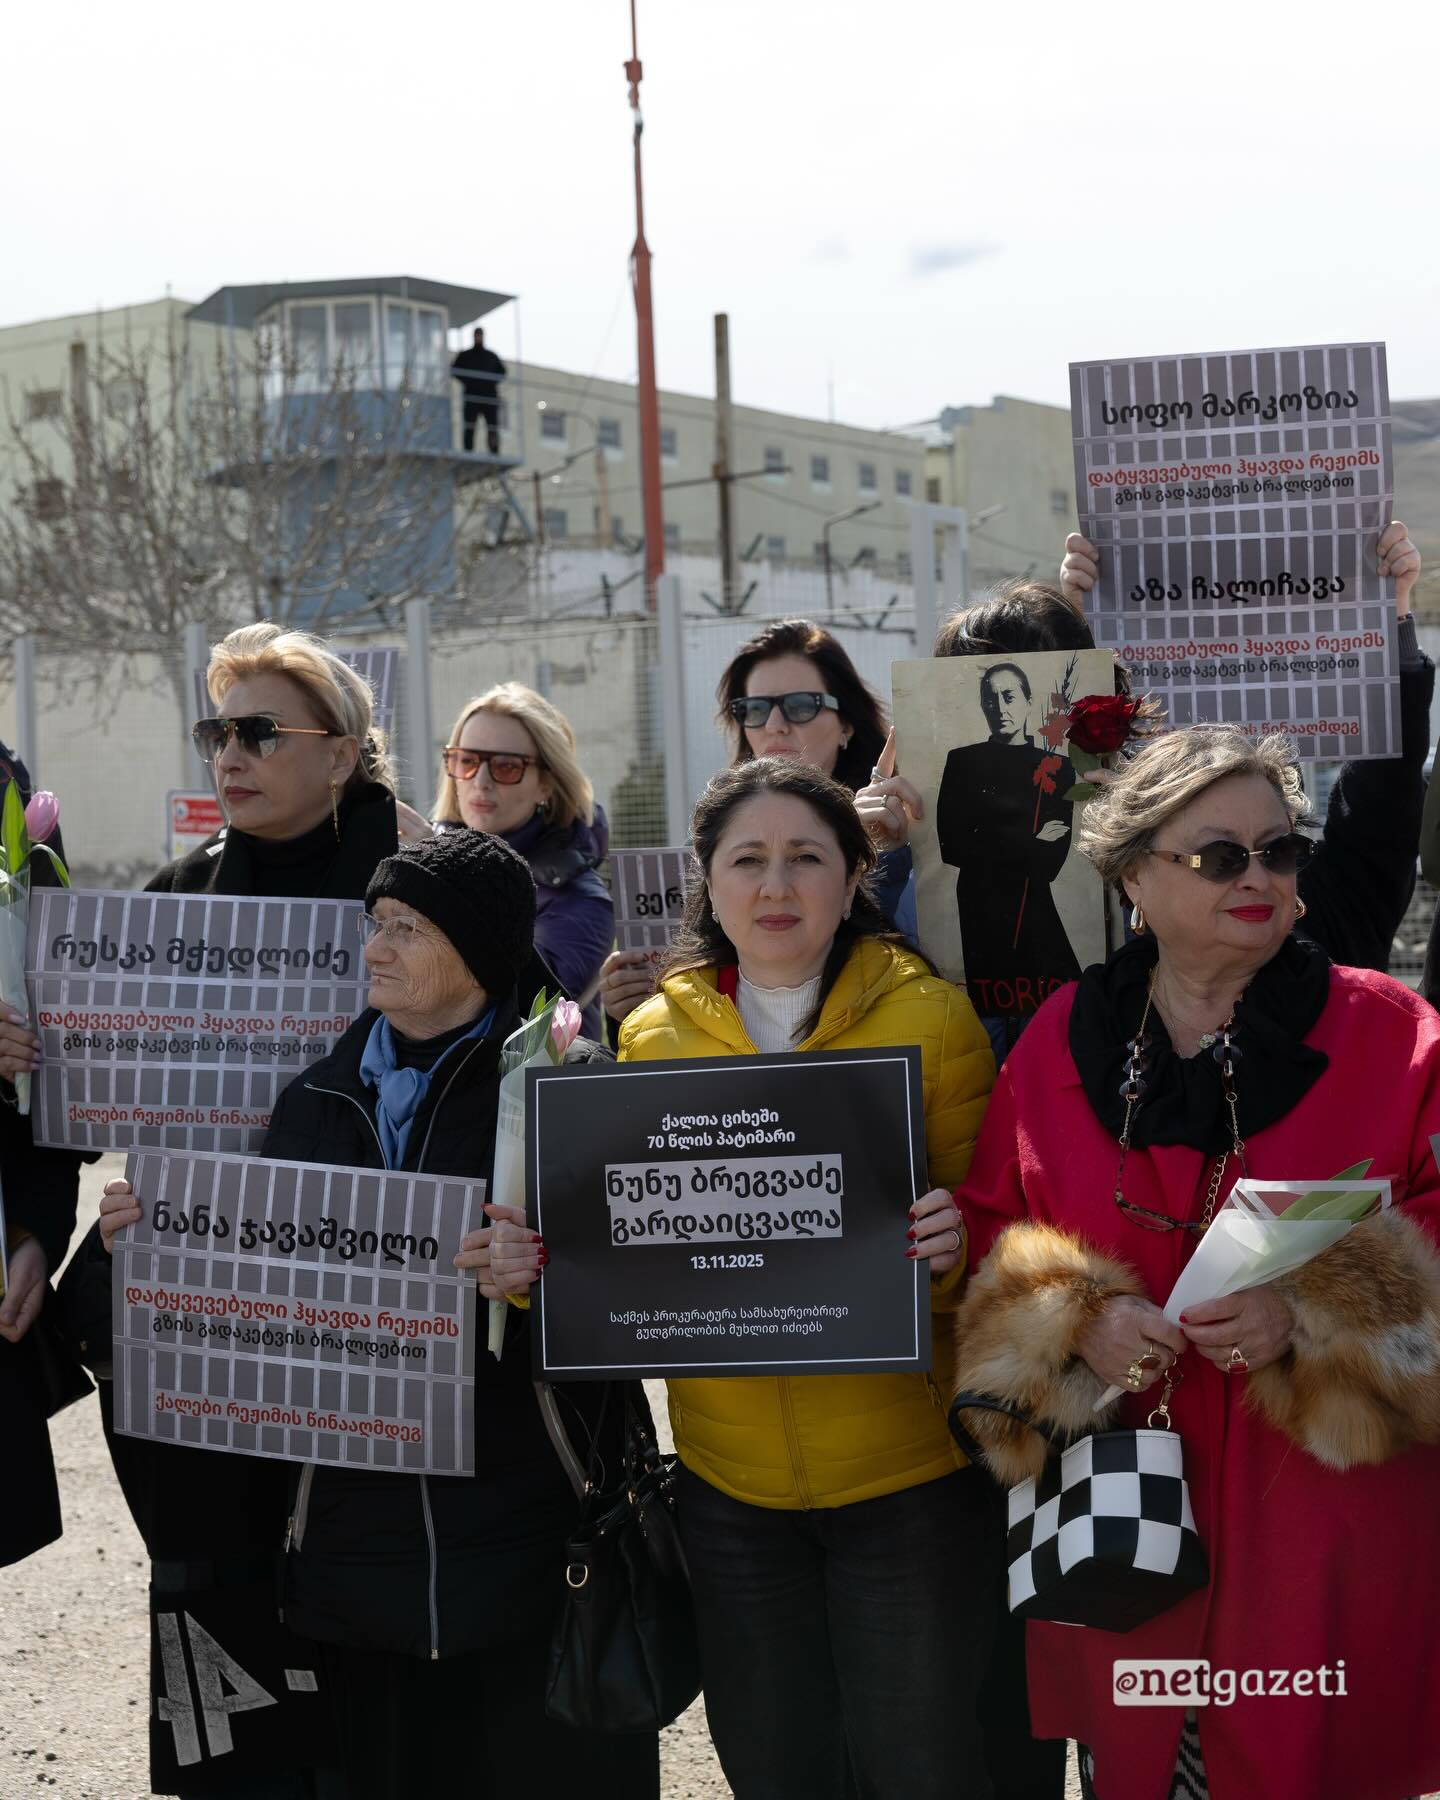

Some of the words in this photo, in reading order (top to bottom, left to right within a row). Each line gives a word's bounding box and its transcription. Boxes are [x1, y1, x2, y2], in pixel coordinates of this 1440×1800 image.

[1101, 399, 1193, 428] სოფო
[1202, 385, 1359, 420] მარკოზია
[1088, 463, 1232, 486] დატყვევებული
[1236, 456, 1304, 478] ჰყავდა
[1309, 449, 1380, 471] რეჟიმს
[1115, 487, 1152, 505] გზის
[1155, 481, 1250, 502] გადაკეტვის
[1253, 475, 1355, 494] ბრალდებით
[1130, 579, 1182, 602] აზა
[1191, 571, 1345, 603] ჩალიჩავა
[1113, 640, 1239, 662] ტყვევებული
[1243, 638, 1311, 657] ჰყავდა
[1315, 631, 1385, 653] რეჟიმს
[1162, 659, 1256, 680] გადაკეტვის
[1259, 657, 1360, 674] ბრალდებით
[51, 934, 157, 971] რუსკა
[165, 938, 351, 976] მჭედლიძე
[38, 1009, 196, 1031] დატყვევებული
[200, 1012, 275, 1032] ჰყავდა
[63, 1035, 102, 1051] გზის
[105, 1037, 211, 1054] გადაკეტვის
[215, 1037, 327, 1057] ბრალდებით
[69, 1104, 128, 1125] ქალები
[133, 1107, 206, 1127] რეჟიმის
[209, 1111, 272, 1129] წინააღ
[662, 1113, 719, 1131] ქალთა
[722, 1108, 779, 1128] ციხეში
[648, 1135, 665, 1149] 70
[668, 1133, 713, 1150] წლის
[717, 1129, 796, 1148] პატიმარი
[607, 1168, 682, 1203] ნუნუ
[691, 1161, 842, 1199] ბრეგვაძე
[152, 1201, 230, 1238] ნანა
[239, 1217, 439, 1265] ჯავაშვილი
[612, 1208, 841, 1244] გარდაიცვალა
[690, 1253, 765, 1270] 13.11.2025
[125, 1285, 287, 1321] დატყვევებული
[293, 1302, 371, 1329] ჰყავდა
[376, 1312, 460, 1338] რეჟიმს
[610, 1311, 650, 1325] საქმეს
[653, 1307, 737, 1324] პროკურატურა
[740, 1305, 849, 1319] სამსახურეობრივი
[152, 1316, 194, 1333] გზის
[198, 1322, 305, 1347] გადაკეტვის
[309, 1334, 428, 1359] ბრალდებით
[636, 1325, 726, 1340] გულგრილობის
[729, 1323, 779, 1336] მუხლით
[782, 1321, 823, 1335] იძიებს
[155, 1393, 222, 1416] ქალები
[226, 1402, 302, 1427] რეჟიმის
[306, 1412, 422, 1443] წინააღმდეგ
